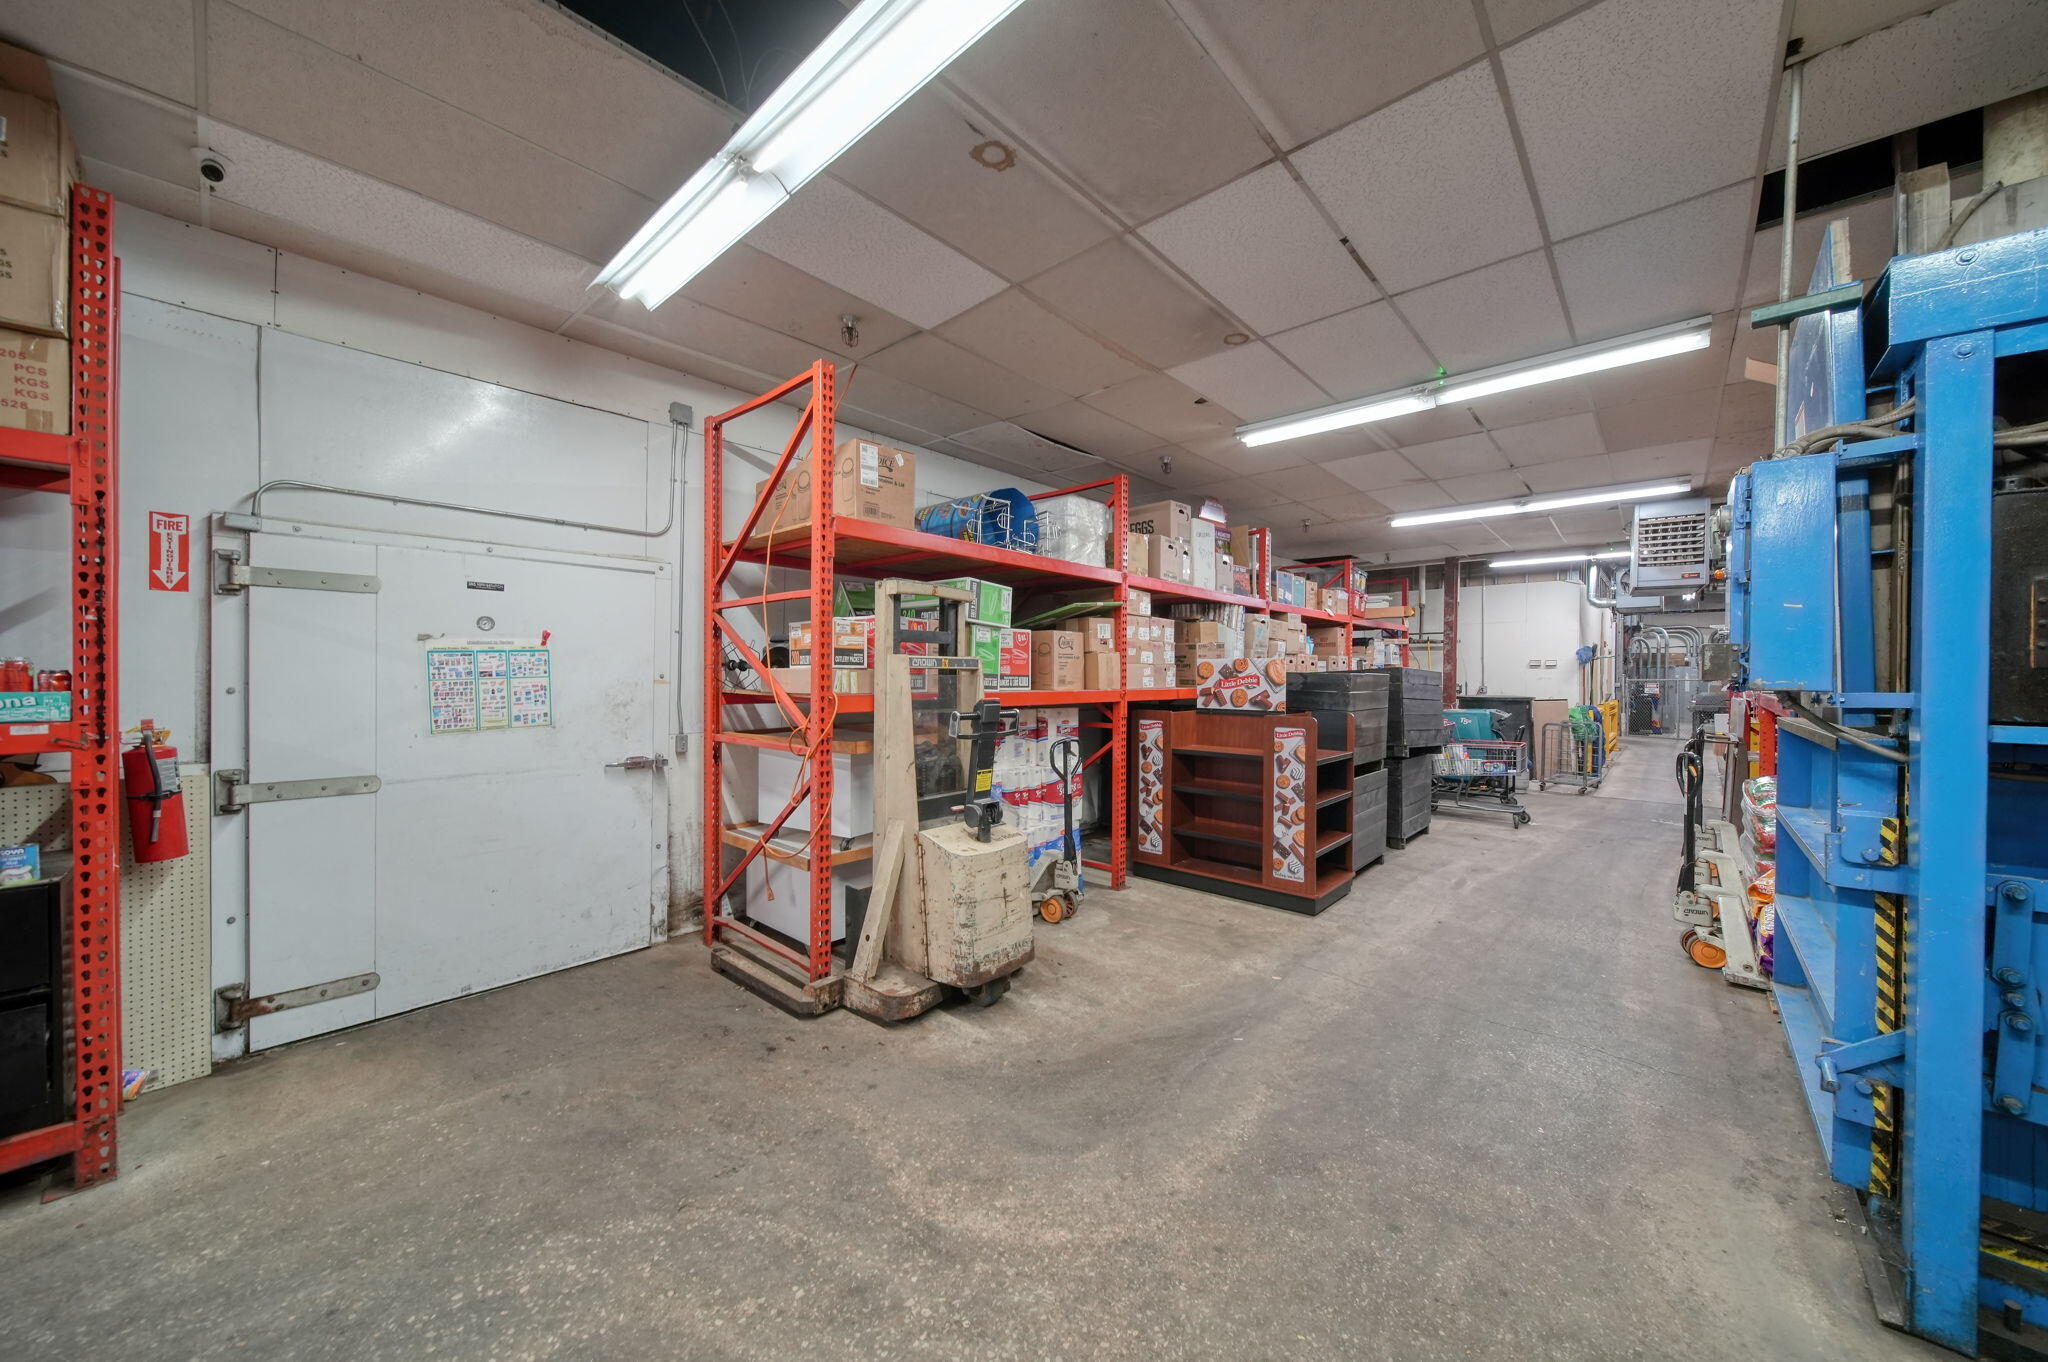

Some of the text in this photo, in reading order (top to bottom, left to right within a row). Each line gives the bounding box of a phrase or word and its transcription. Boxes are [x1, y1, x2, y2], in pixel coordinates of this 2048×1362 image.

[14, 363, 48, 376] PCS
[14, 376, 49, 389] KGS
[14, 388, 50, 401] KGS
[156, 519, 183, 531] FIRE
[1129, 520, 1154, 535] EGGS
[1221, 677, 1258, 688] Little Debbie
